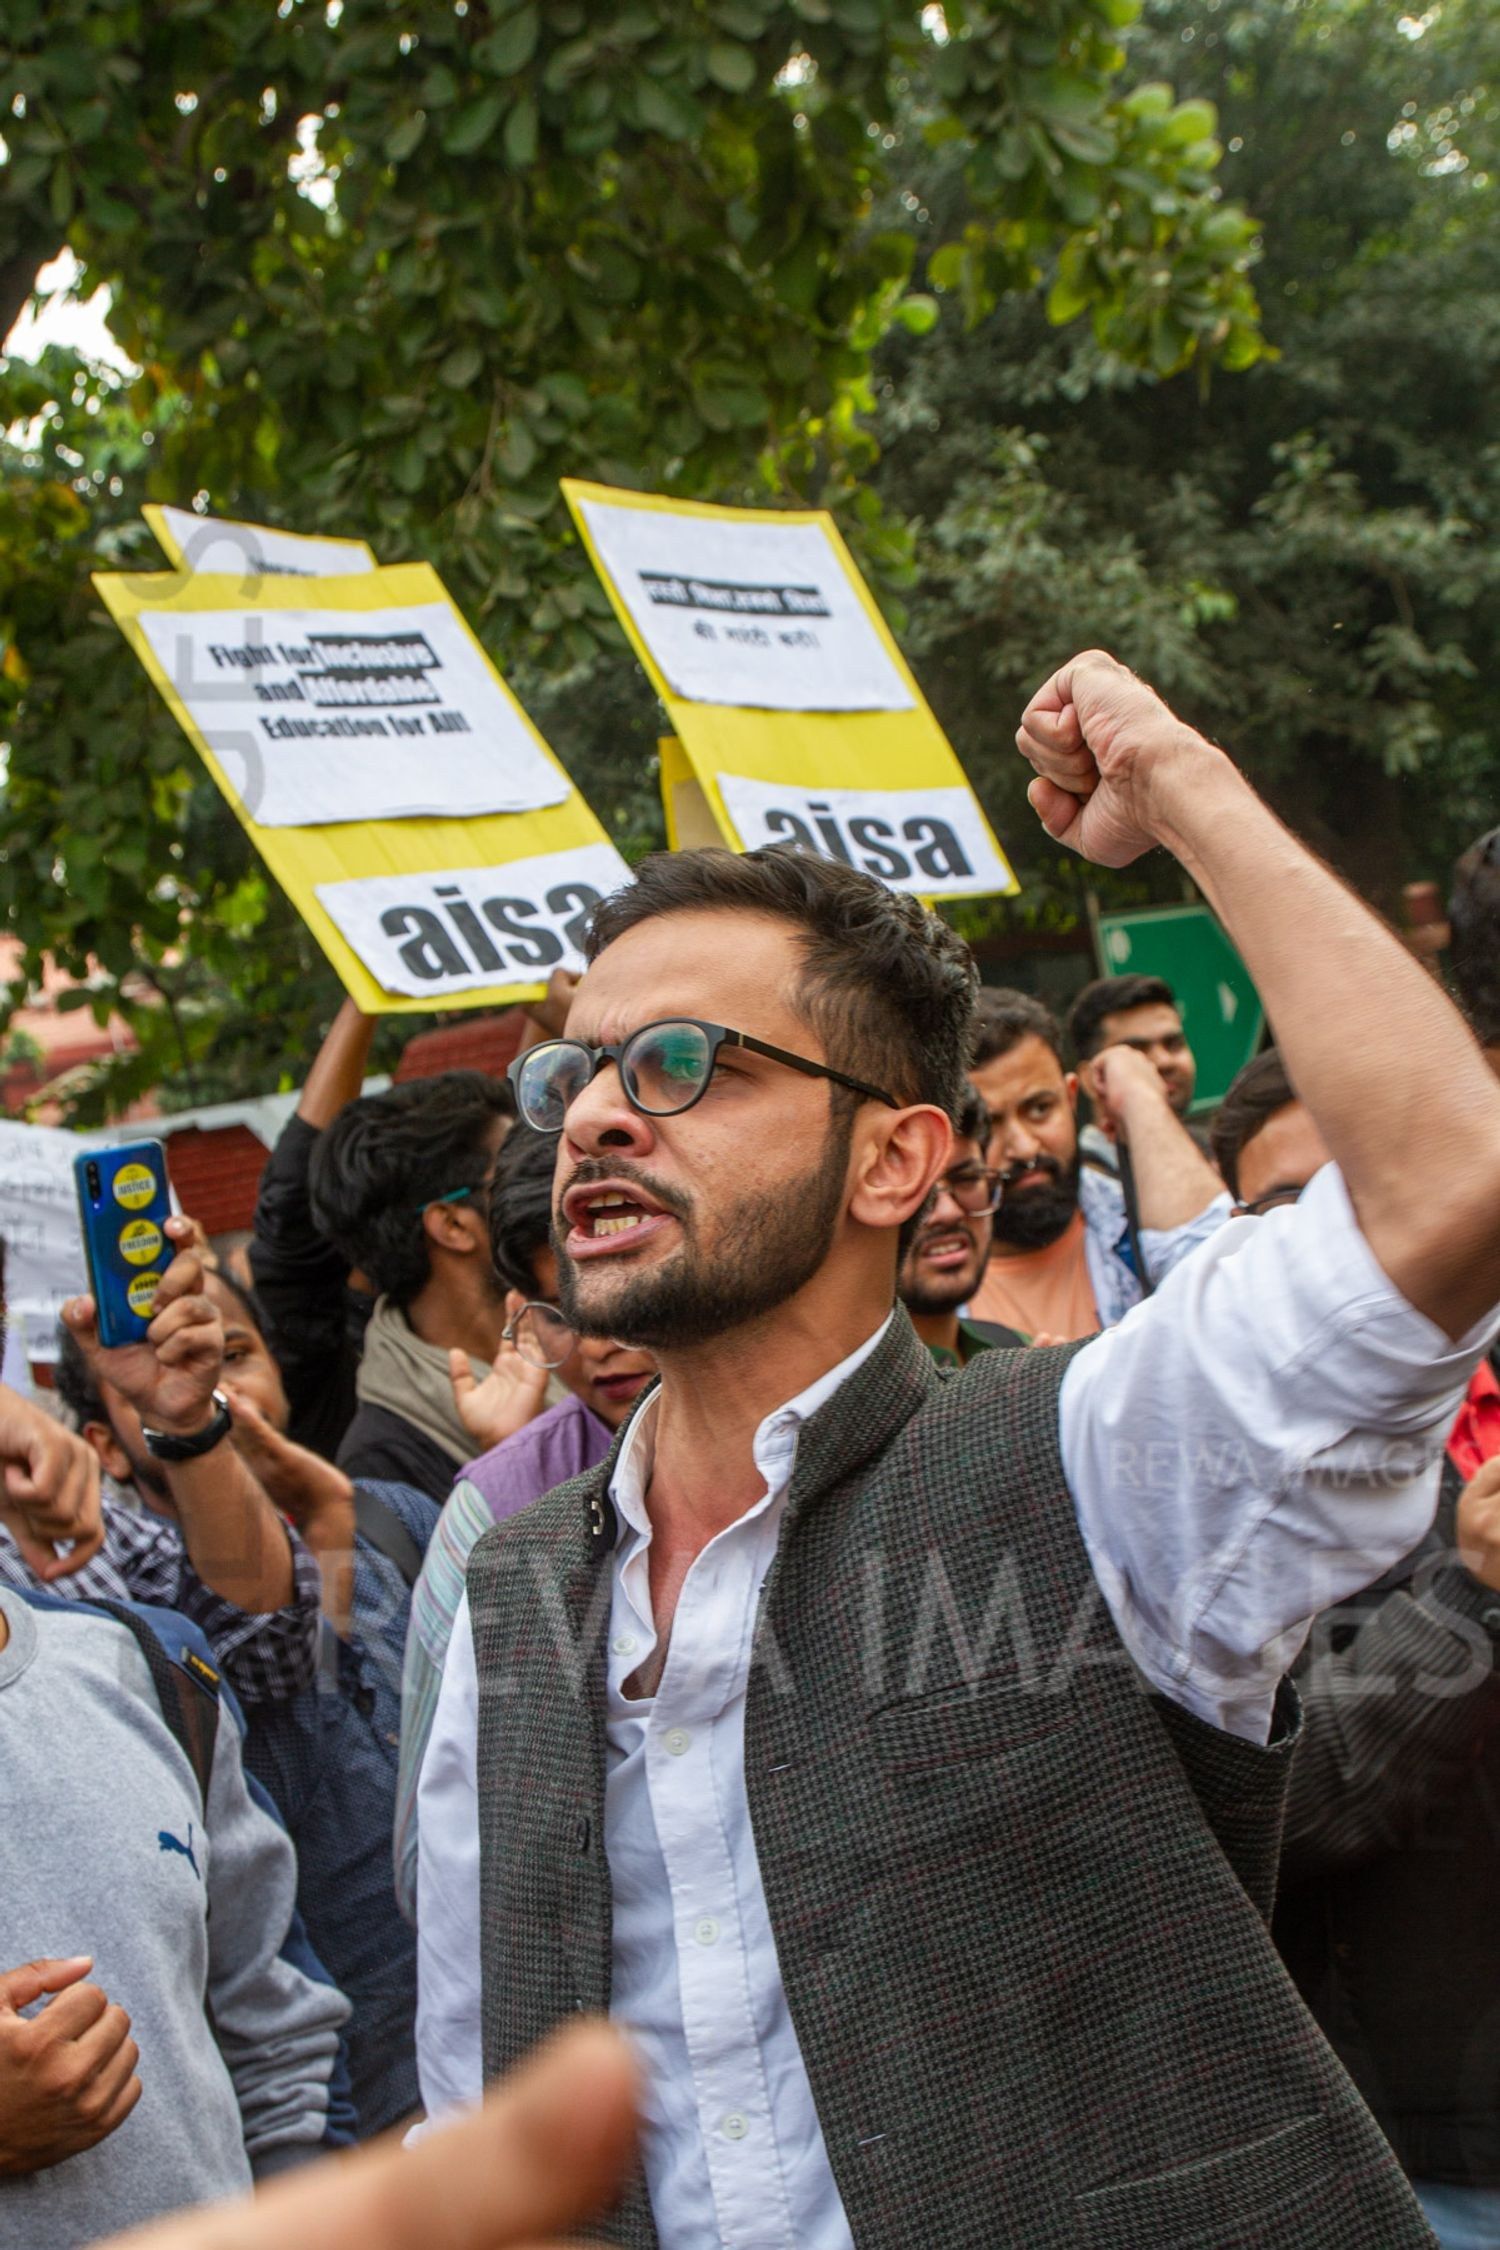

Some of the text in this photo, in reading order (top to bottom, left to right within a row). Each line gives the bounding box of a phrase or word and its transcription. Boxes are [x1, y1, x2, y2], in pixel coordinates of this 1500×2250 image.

[208, 639, 437, 668] Fight for Inclusive
[254, 674, 440, 704] and Affordable
[259, 715, 390, 741] Education
[387, 713, 426, 736] for
[764, 803, 975, 879] aisa
[380, 886, 600, 980] aisa
[117, 1179, 151, 1195] JUSTICE
[122, 1234, 160, 1251] FREEDOM
